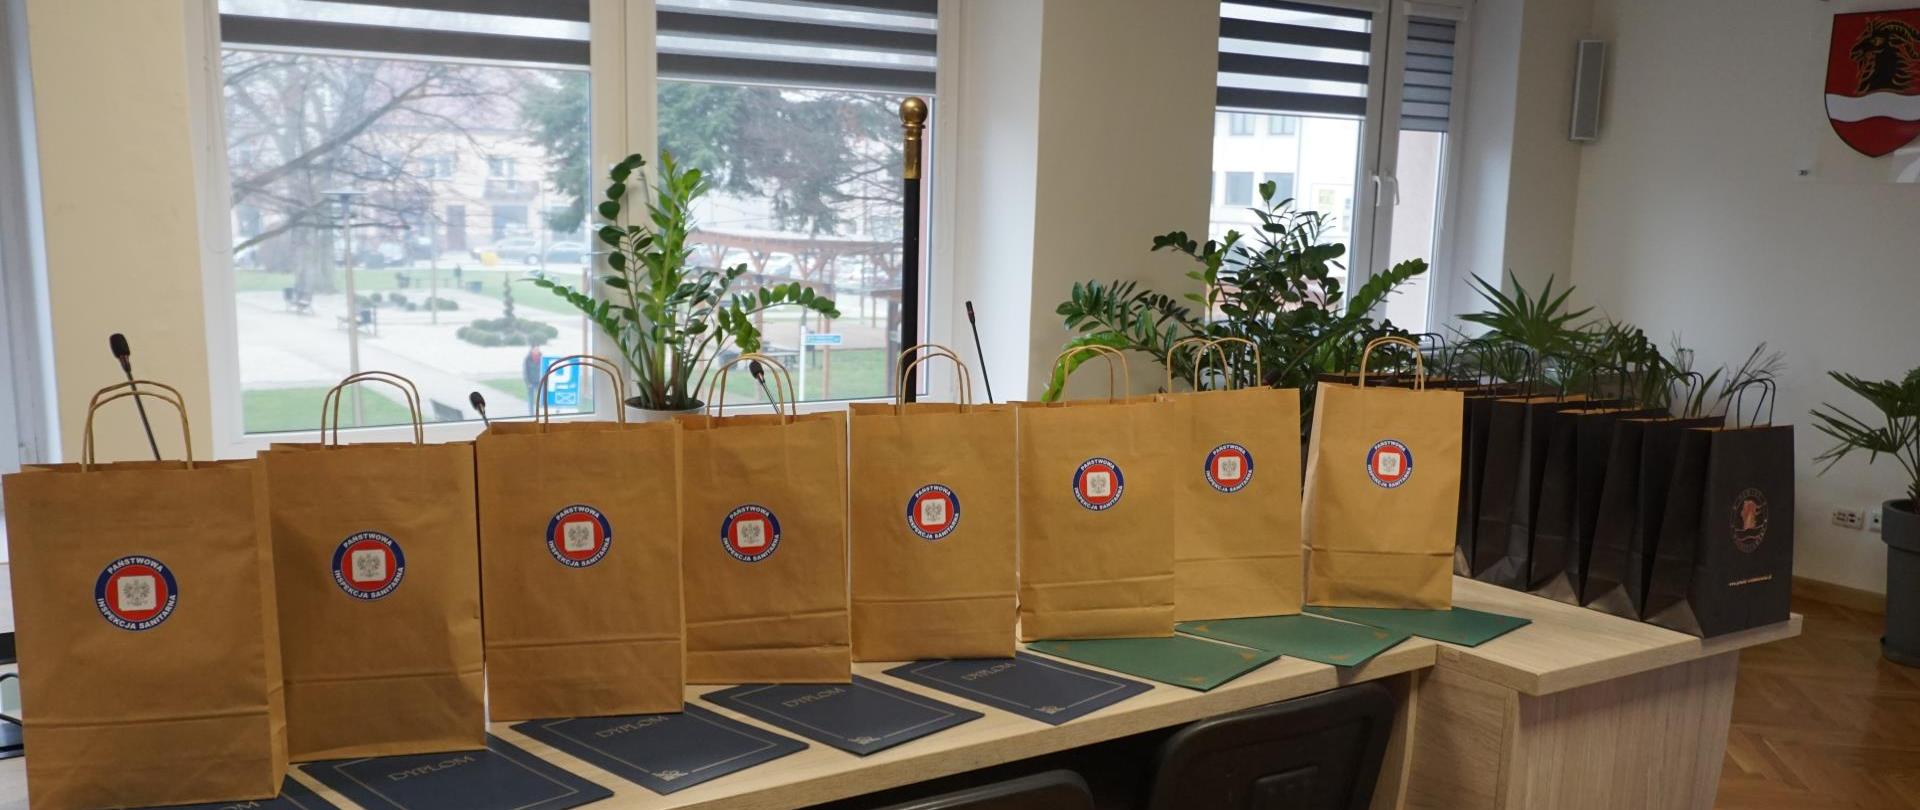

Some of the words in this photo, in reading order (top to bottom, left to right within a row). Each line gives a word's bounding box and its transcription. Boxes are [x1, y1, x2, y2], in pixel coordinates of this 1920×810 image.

[781, 686, 846, 707] DYPLOM
[595, 715, 669, 738] DYPLOM
[387, 755, 475, 781] DYPLOM
